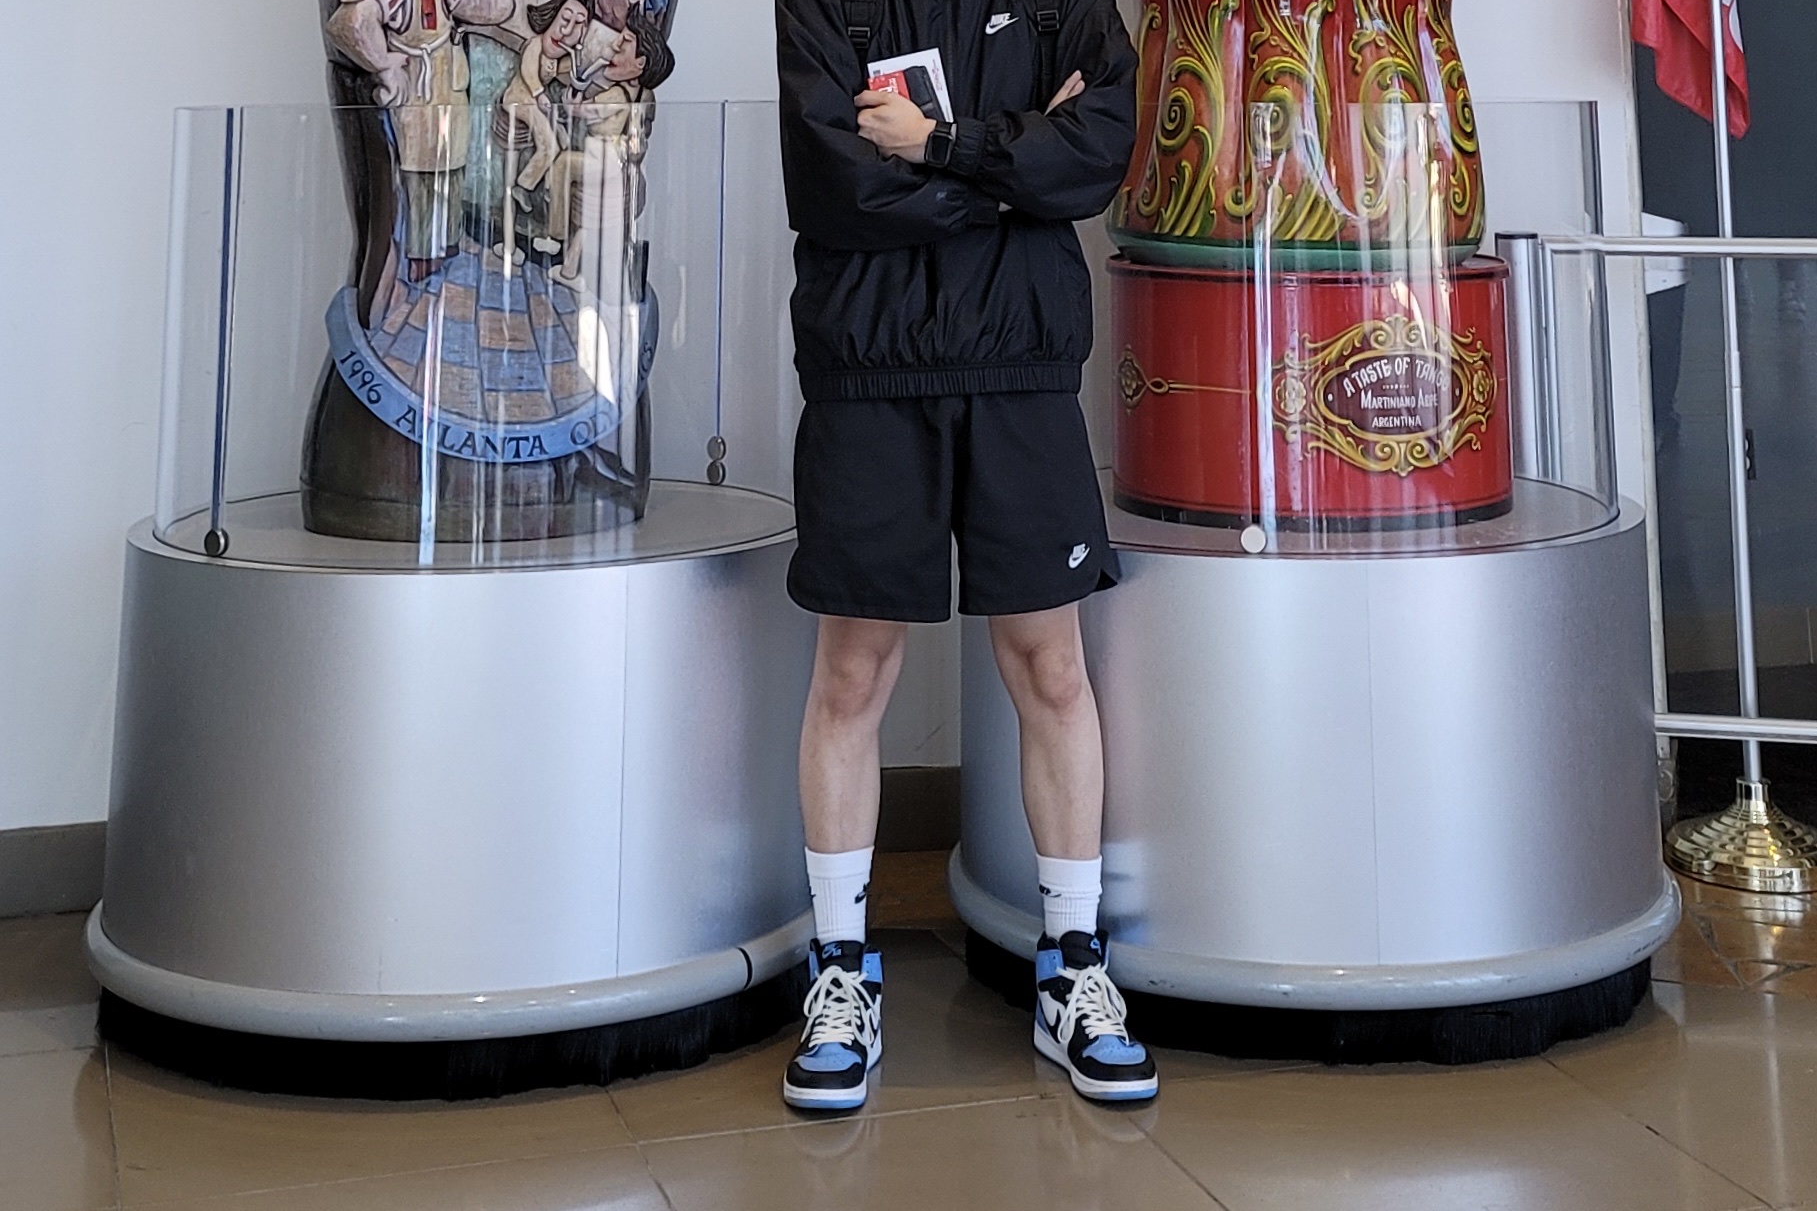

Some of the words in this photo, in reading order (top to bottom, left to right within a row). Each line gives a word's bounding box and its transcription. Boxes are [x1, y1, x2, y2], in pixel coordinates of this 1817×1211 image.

[340, 349, 383, 405] 1996
[1342, 378, 1355, 397] A
[1351, 359, 1392, 390] TASTE
[1395, 357, 1411, 376] OF
[1371, 415, 1422, 428] ARGENTINA
